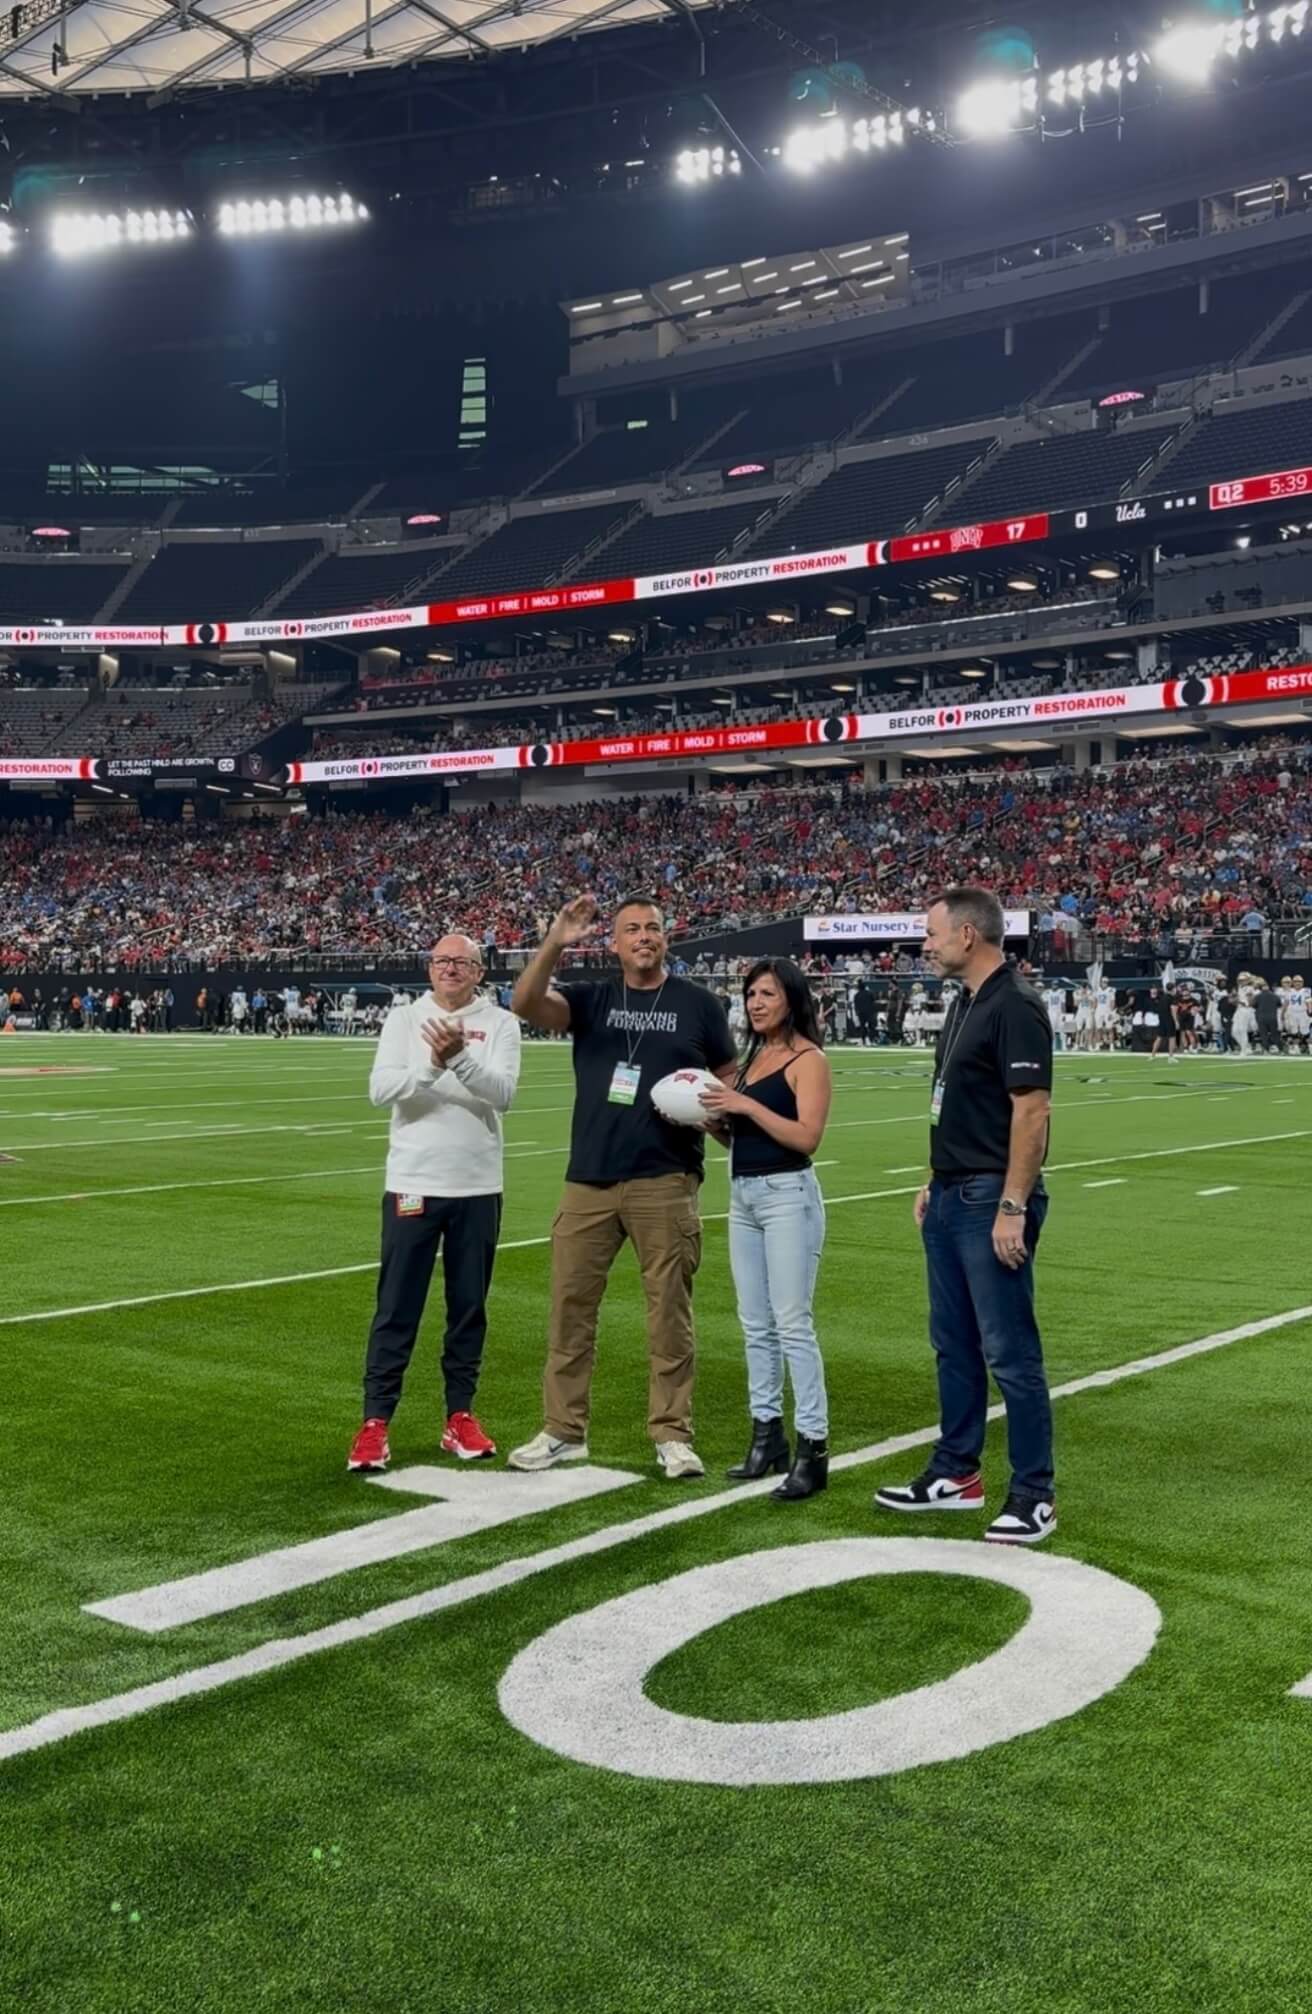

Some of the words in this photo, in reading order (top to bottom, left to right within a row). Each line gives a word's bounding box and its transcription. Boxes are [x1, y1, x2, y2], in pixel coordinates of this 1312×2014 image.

[1217, 483, 1244, 504] Q2
[1269, 474, 1308, 495] 5:39
[1006, 522, 1026, 540] 17
[1075, 511, 1087, 529] 0
[653, 577, 691, 592] BELFOR
[715, 566, 770, 582] PROPERTY
[773, 554, 847, 574] RESTORATION
[456, 604, 487, 617] WATER
[499, 600, 520, 611] FIRE
[531, 595, 559, 608] MOLD
[570, 589, 605, 603] STORM
[37, 631, 91, 640] PROPERTY
[244, 627, 282, 637] BELFOR
[304, 621, 350, 633] PROPERTY
[352, 613, 412, 629] RESTORATION
[889, 715, 935, 729] BELFOR
[965, 705, 1031, 722] PROPERTY
[1034, 694, 1126, 714] RESTORATION
[600, 743, 634, 755] WATER
[647, 739, 671, 751] FIRE
[684, 735, 714, 749] MOLD
[728, 731, 767, 745] STORM
[324, 765, 359, 776] BELFOR
[380, 760, 428, 772] PROPERTY
[430, 755, 494, 769] RESTORATION
[832, 921, 858, 933] Star
[862, 921, 910, 934] Nursery
